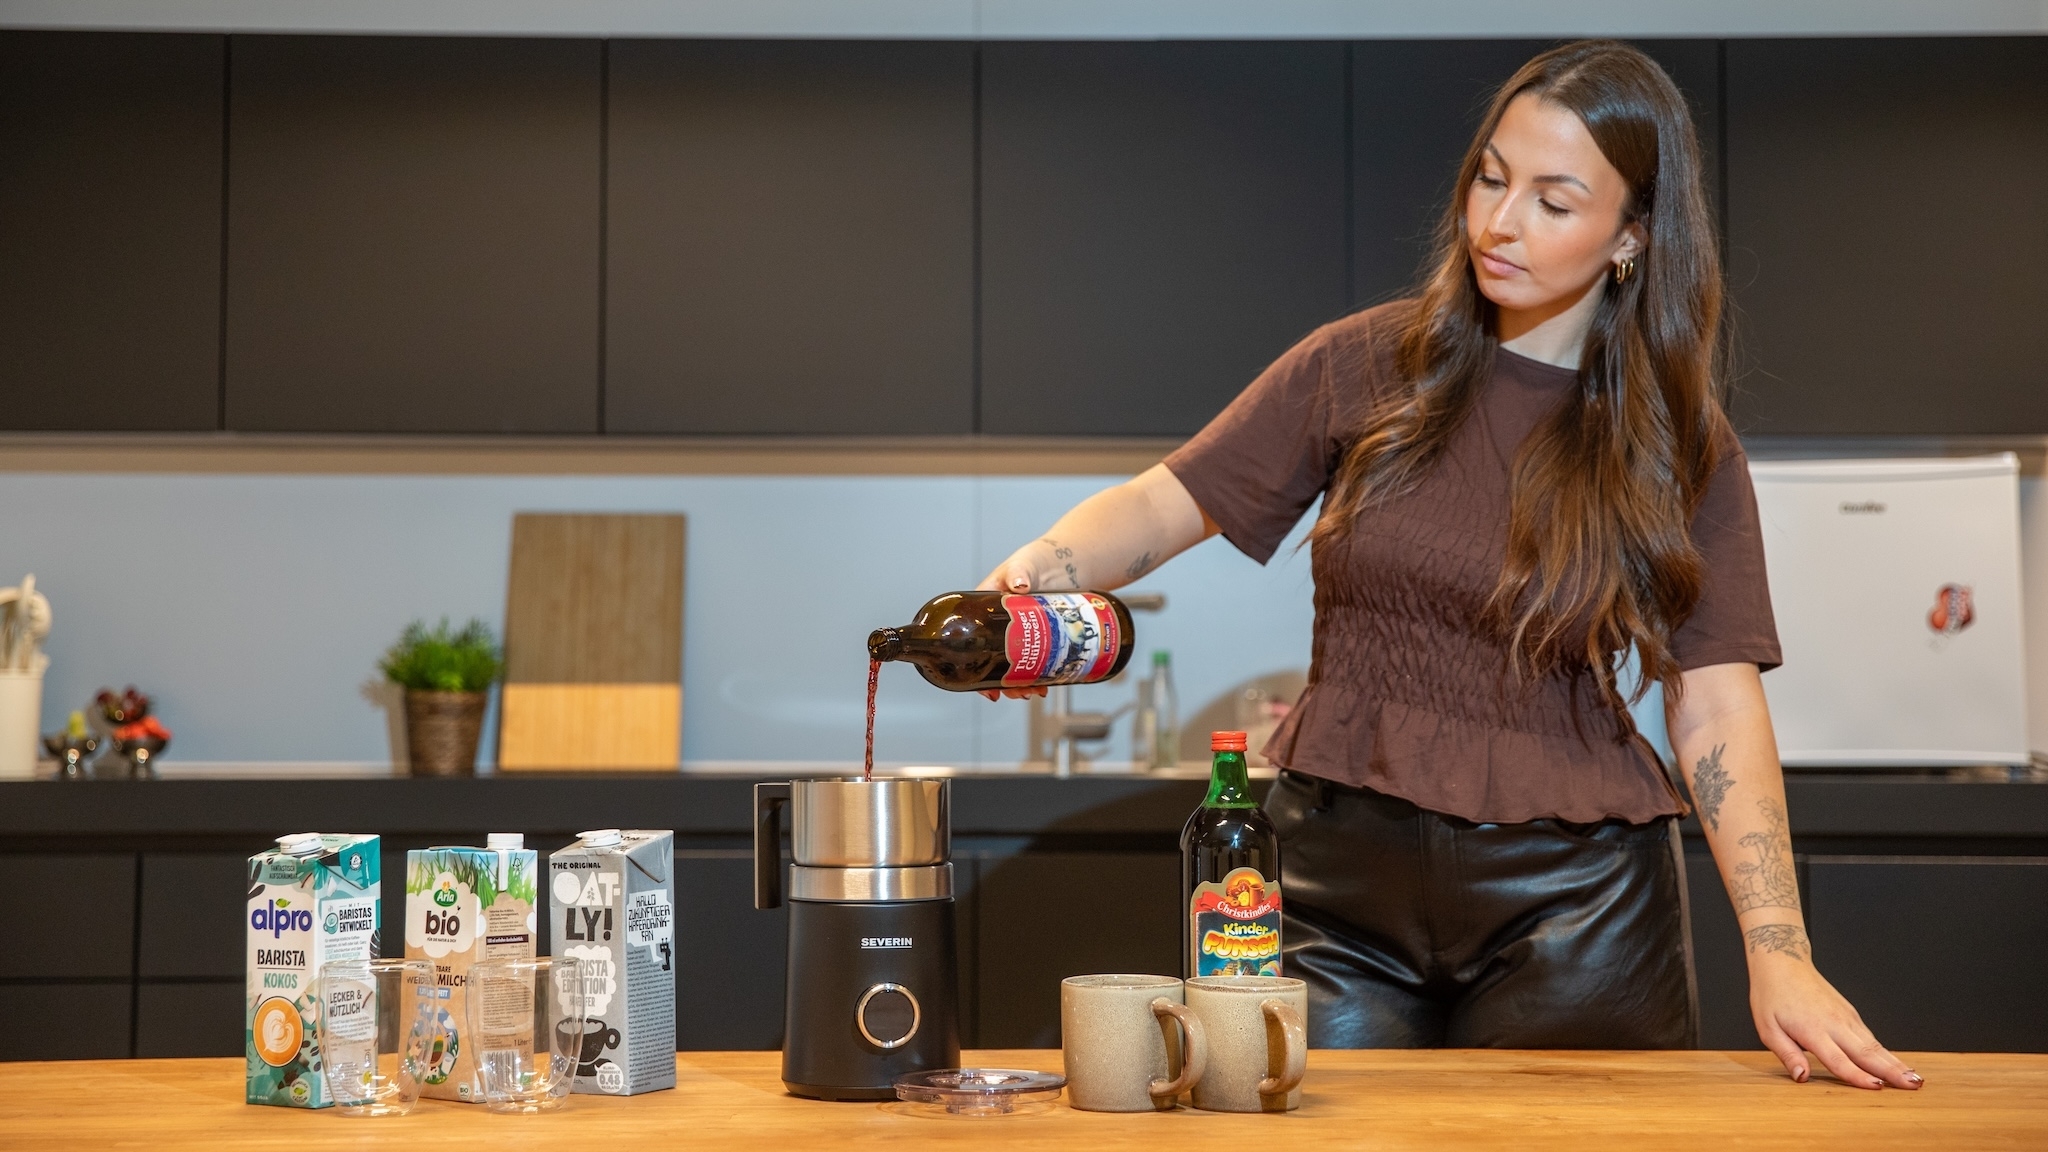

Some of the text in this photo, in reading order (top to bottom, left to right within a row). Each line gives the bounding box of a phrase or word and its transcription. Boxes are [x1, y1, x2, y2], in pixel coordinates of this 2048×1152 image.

[1014, 610, 1032, 673] Thüringer
[1025, 610, 1041, 671] Glühwein
[552, 862, 568, 870] THE
[437, 891, 455, 903] Arla
[636, 894, 656, 907] HALLO
[251, 899, 313, 939] alpro
[339, 907, 372, 921] BARISTAS
[340, 919, 373, 933] ENTWICKELT
[425, 910, 460, 936] bio
[565, 907, 613, 942] LY!
[1223, 922, 1269, 937] Kinder
[641, 930, 654, 942] FAN
[861, 937, 913, 947] SEVERIN
[1203, 931, 1279, 959] PUNSCH
[257, 948, 306, 967] BARISTA
[436, 965, 451, 973] TBARE
[263, 972, 298, 989] KOKOS
[329, 990, 363, 1004] LECKER &
[329, 1003, 361, 1018] NÜTZLICH
[599, 1074, 621, 1086] 0.48
